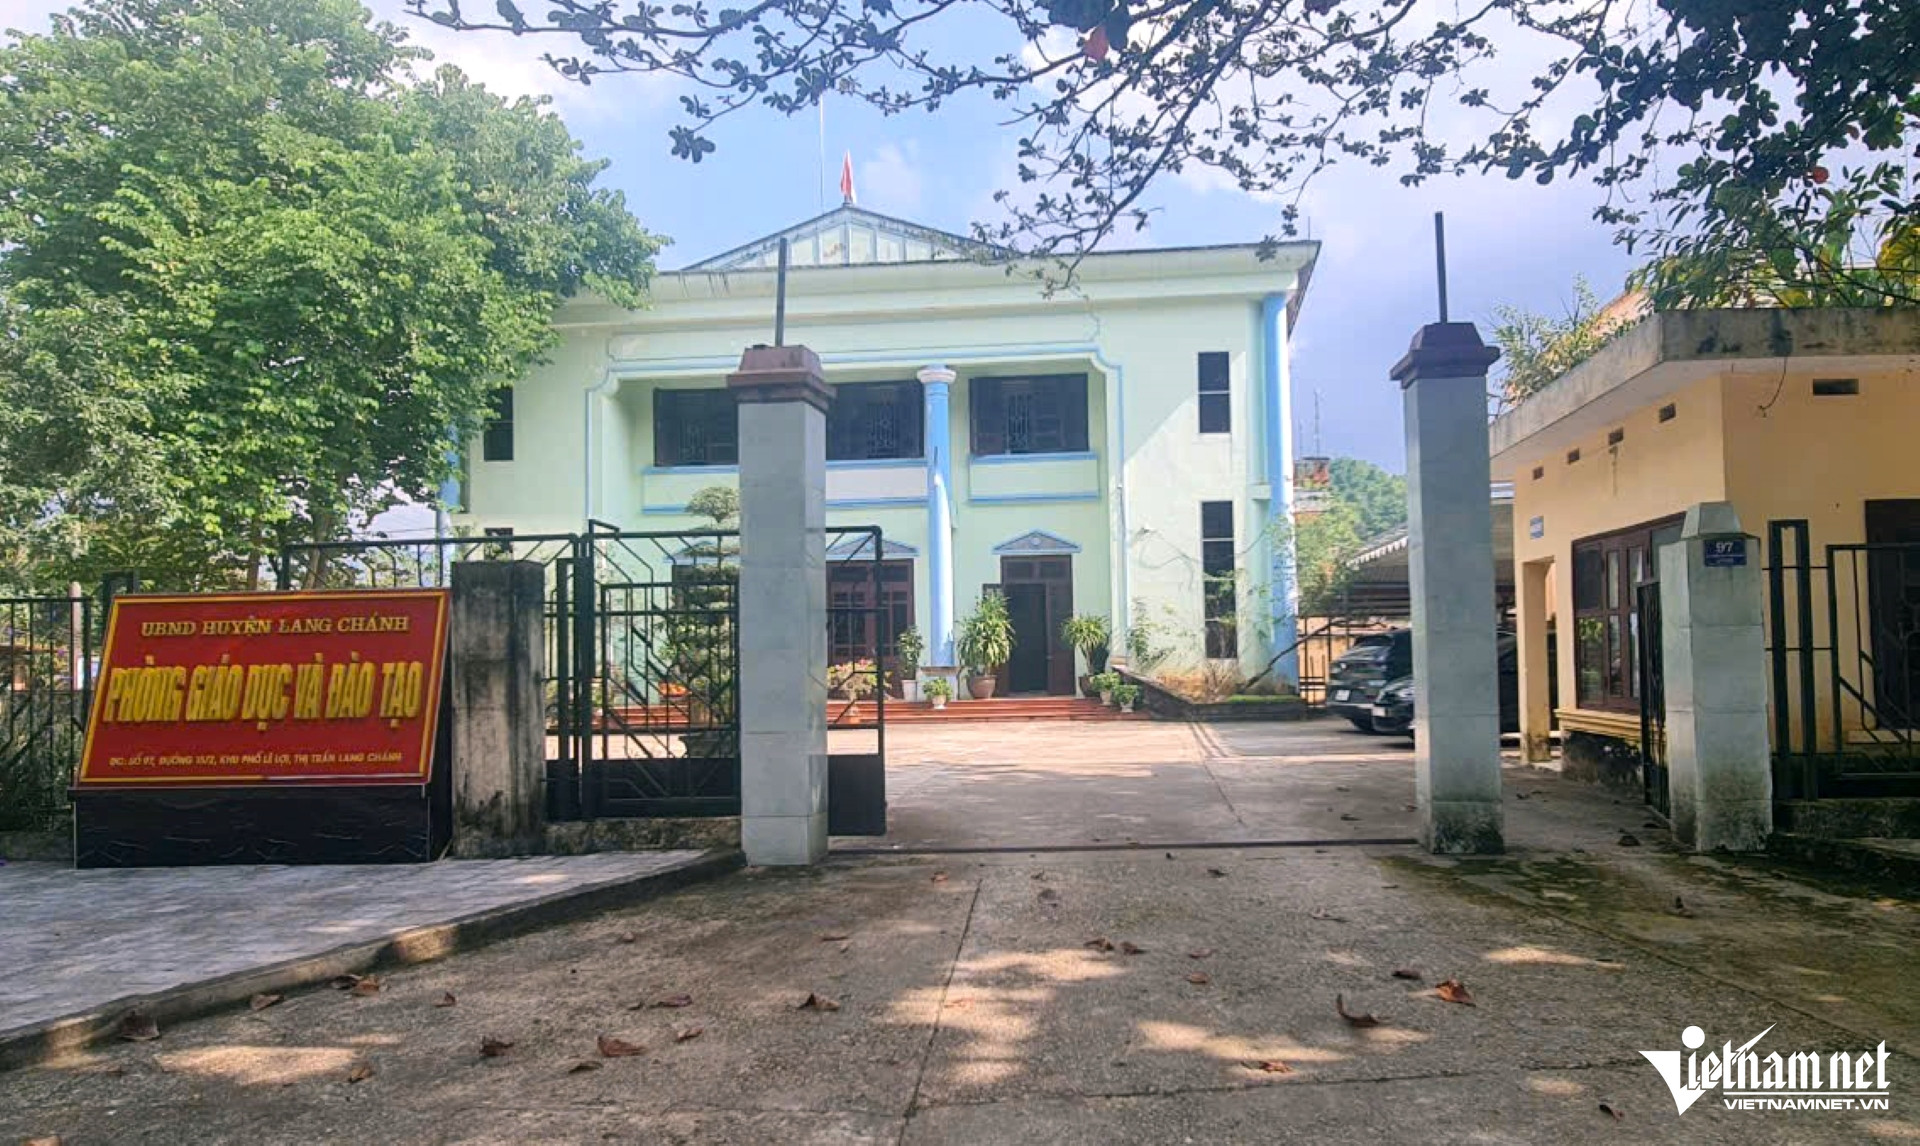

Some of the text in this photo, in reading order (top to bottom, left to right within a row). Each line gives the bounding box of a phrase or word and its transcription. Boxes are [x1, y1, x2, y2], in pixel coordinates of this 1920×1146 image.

[1715, 541, 1734, 554] 97
[141, 612, 409, 637] UBND HUYỆN LANG CHÁNH
[103, 651, 423, 730] PHÒNG GIÁO DỤC VÀ ĐÀO TẠO
[219, 756, 239, 764] KHU
[294, 753, 309, 765] THỊ
[337, 752, 364, 763] LANG
[367, 750, 402, 762] CHÁNH
